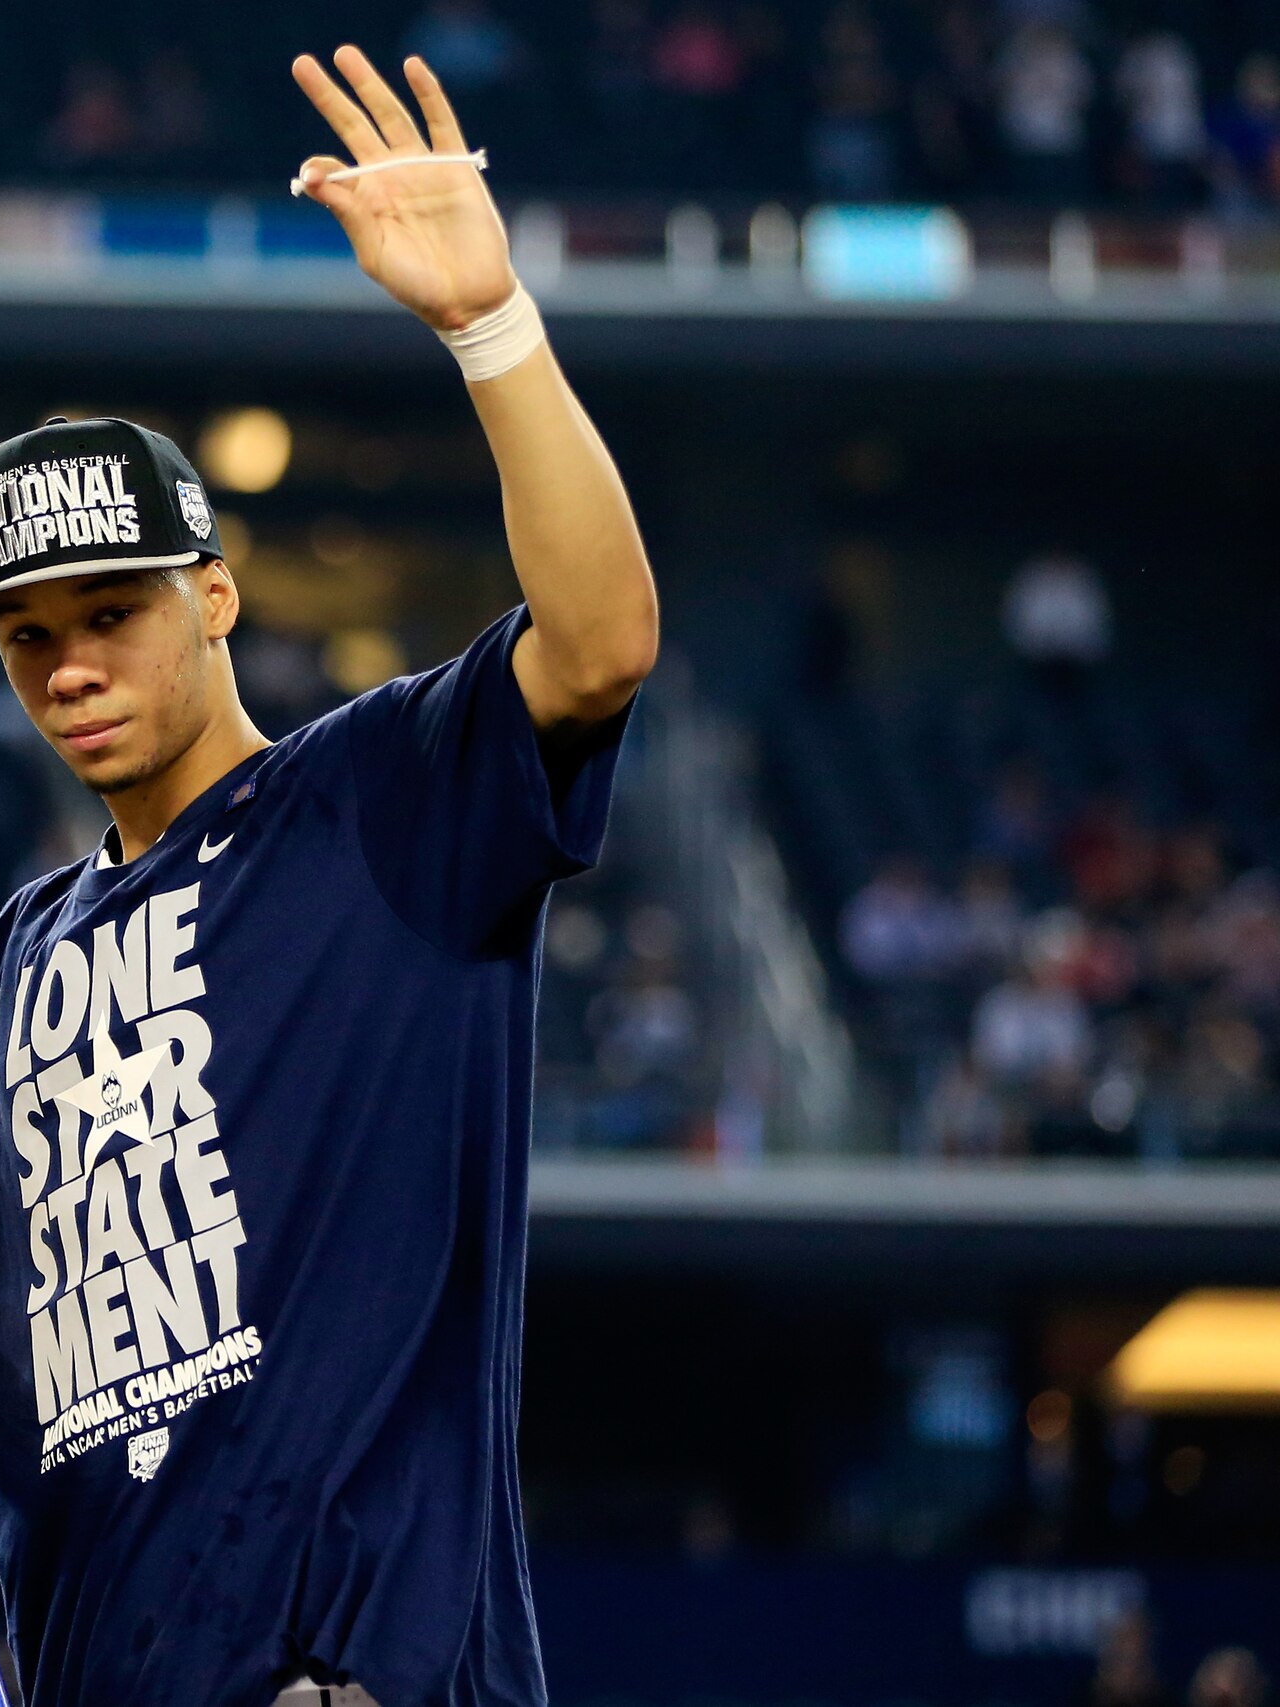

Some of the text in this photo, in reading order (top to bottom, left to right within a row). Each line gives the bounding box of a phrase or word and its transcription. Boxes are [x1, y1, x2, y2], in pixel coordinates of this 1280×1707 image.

[0, 463, 37, 483] MEN'S
[41, 454, 130, 472] BASKETBALL
[5, 880, 207, 1090] LONE
[11, 1008, 218, 1209] STR
[96, 1099, 138, 1129] UCONN
[26, 1110, 239, 1315] STATE
[29, 1215, 248, 1426] MENT
[42, 1325, 262, 1456] NATIONAL CHAMPIONS
[40, 1447, 66, 1475] 2014
[107, 1406, 159, 1440] MEN'S
[163, 1359, 260, 1419] BASETBAL
